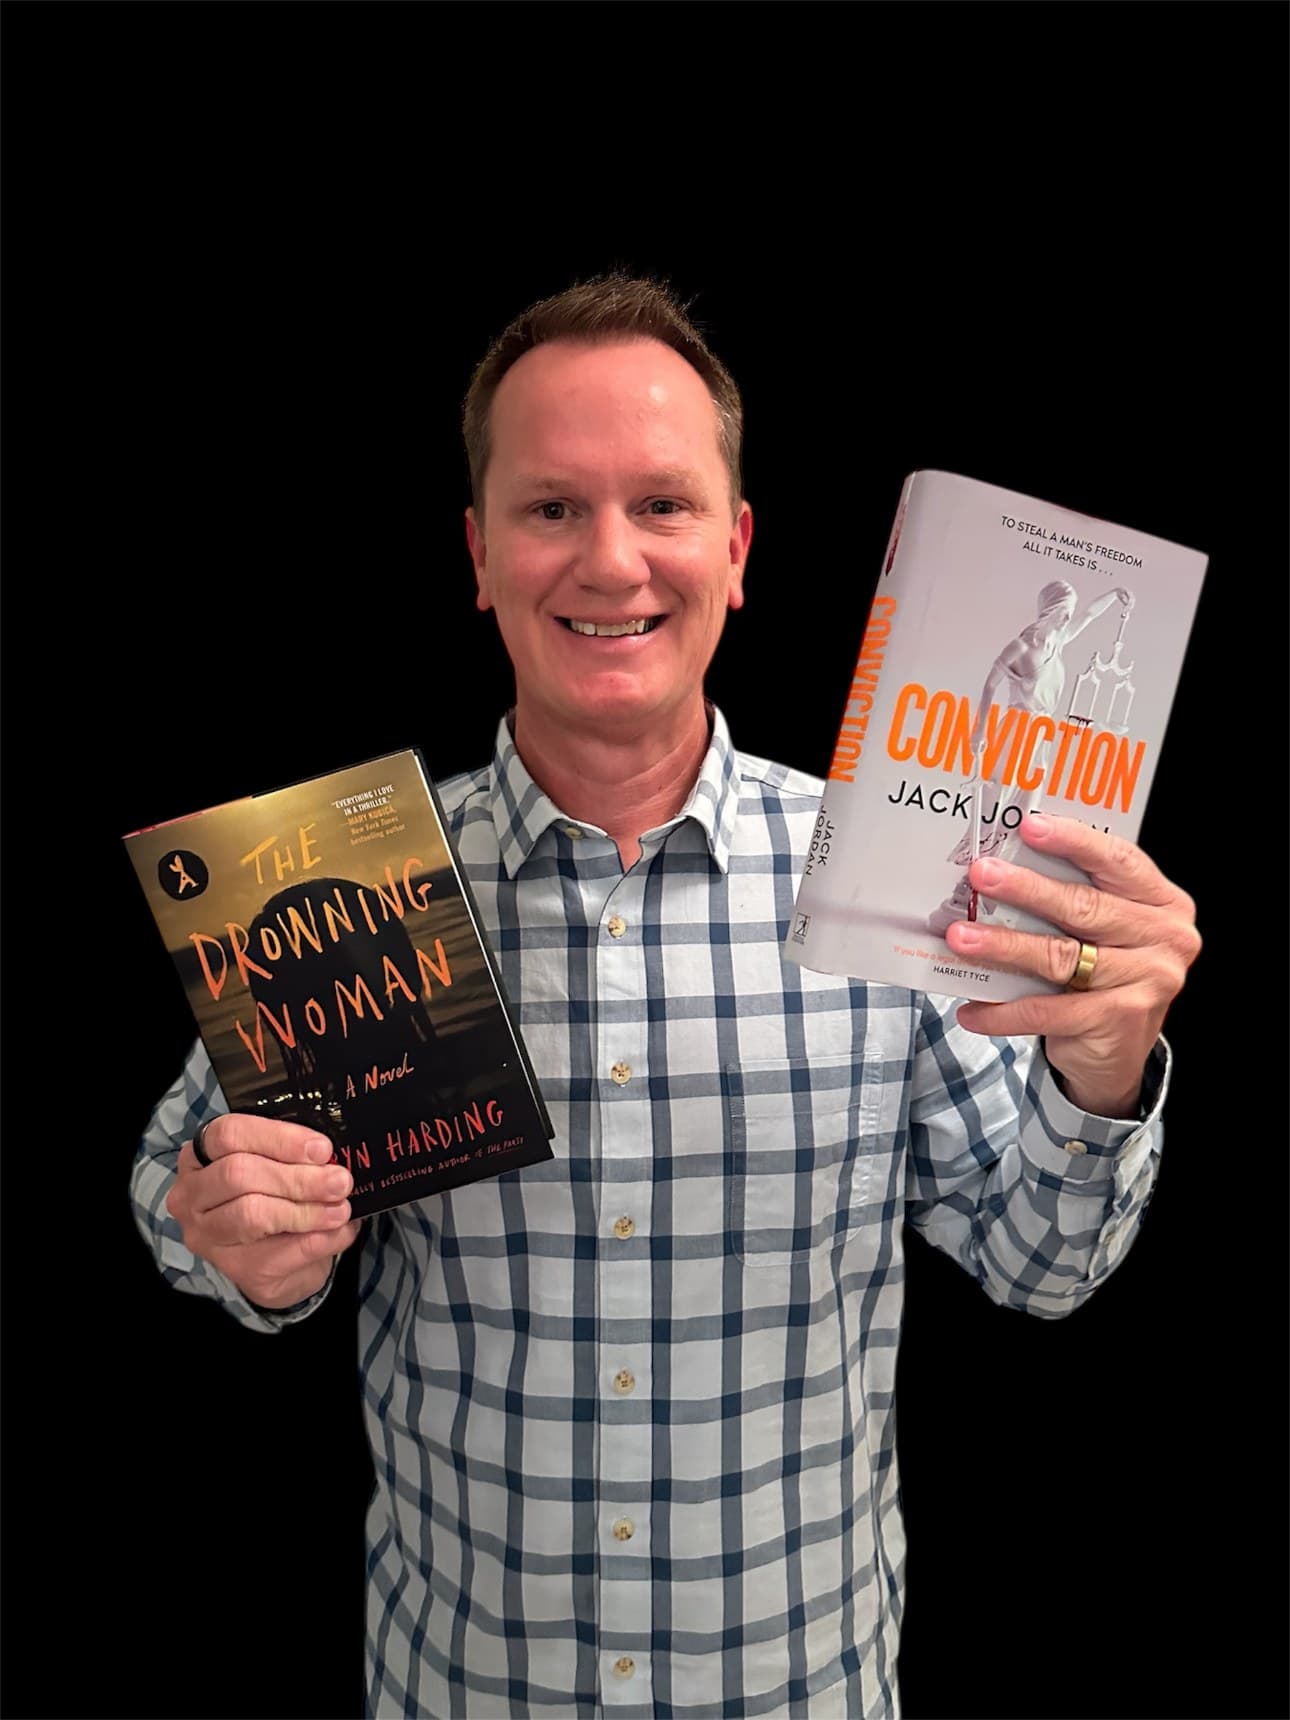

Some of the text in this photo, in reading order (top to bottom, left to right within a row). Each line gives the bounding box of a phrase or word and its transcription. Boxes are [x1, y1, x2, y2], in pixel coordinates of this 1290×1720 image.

[1001, 516, 1143, 568] TO STEAL A MAN'S FREEDOM
[1023, 541, 1042, 555] ALL
[1043, 546, 1053, 557] IT
[1056, 550, 1085, 567] TAKES
[1087, 559, 1098, 571] IS
[828, 596, 897, 783] CONVICTION
[887, 683, 1147, 814] CONVICTION
[343, 807, 353, 817] IN
[352, 805, 359, 813] A
[378, 784, 395, 795] LOVE
[888, 780, 974, 819] JACK
[240, 823, 323, 885] THE
[805, 805, 827, 876] JORDAN
[817, 820, 835, 866] JACK
[188, 857, 433, 1001] DROWNING
[933, 965, 968, 979] HARRIET
[969, 971, 991, 983] TYCE
[235, 938, 452, 1073] WOMAN
[346, 1051, 415, 1100] A Novel
[386, 1100, 504, 1163] HARDING
[437, 1151, 471, 1171] AUTHOR
